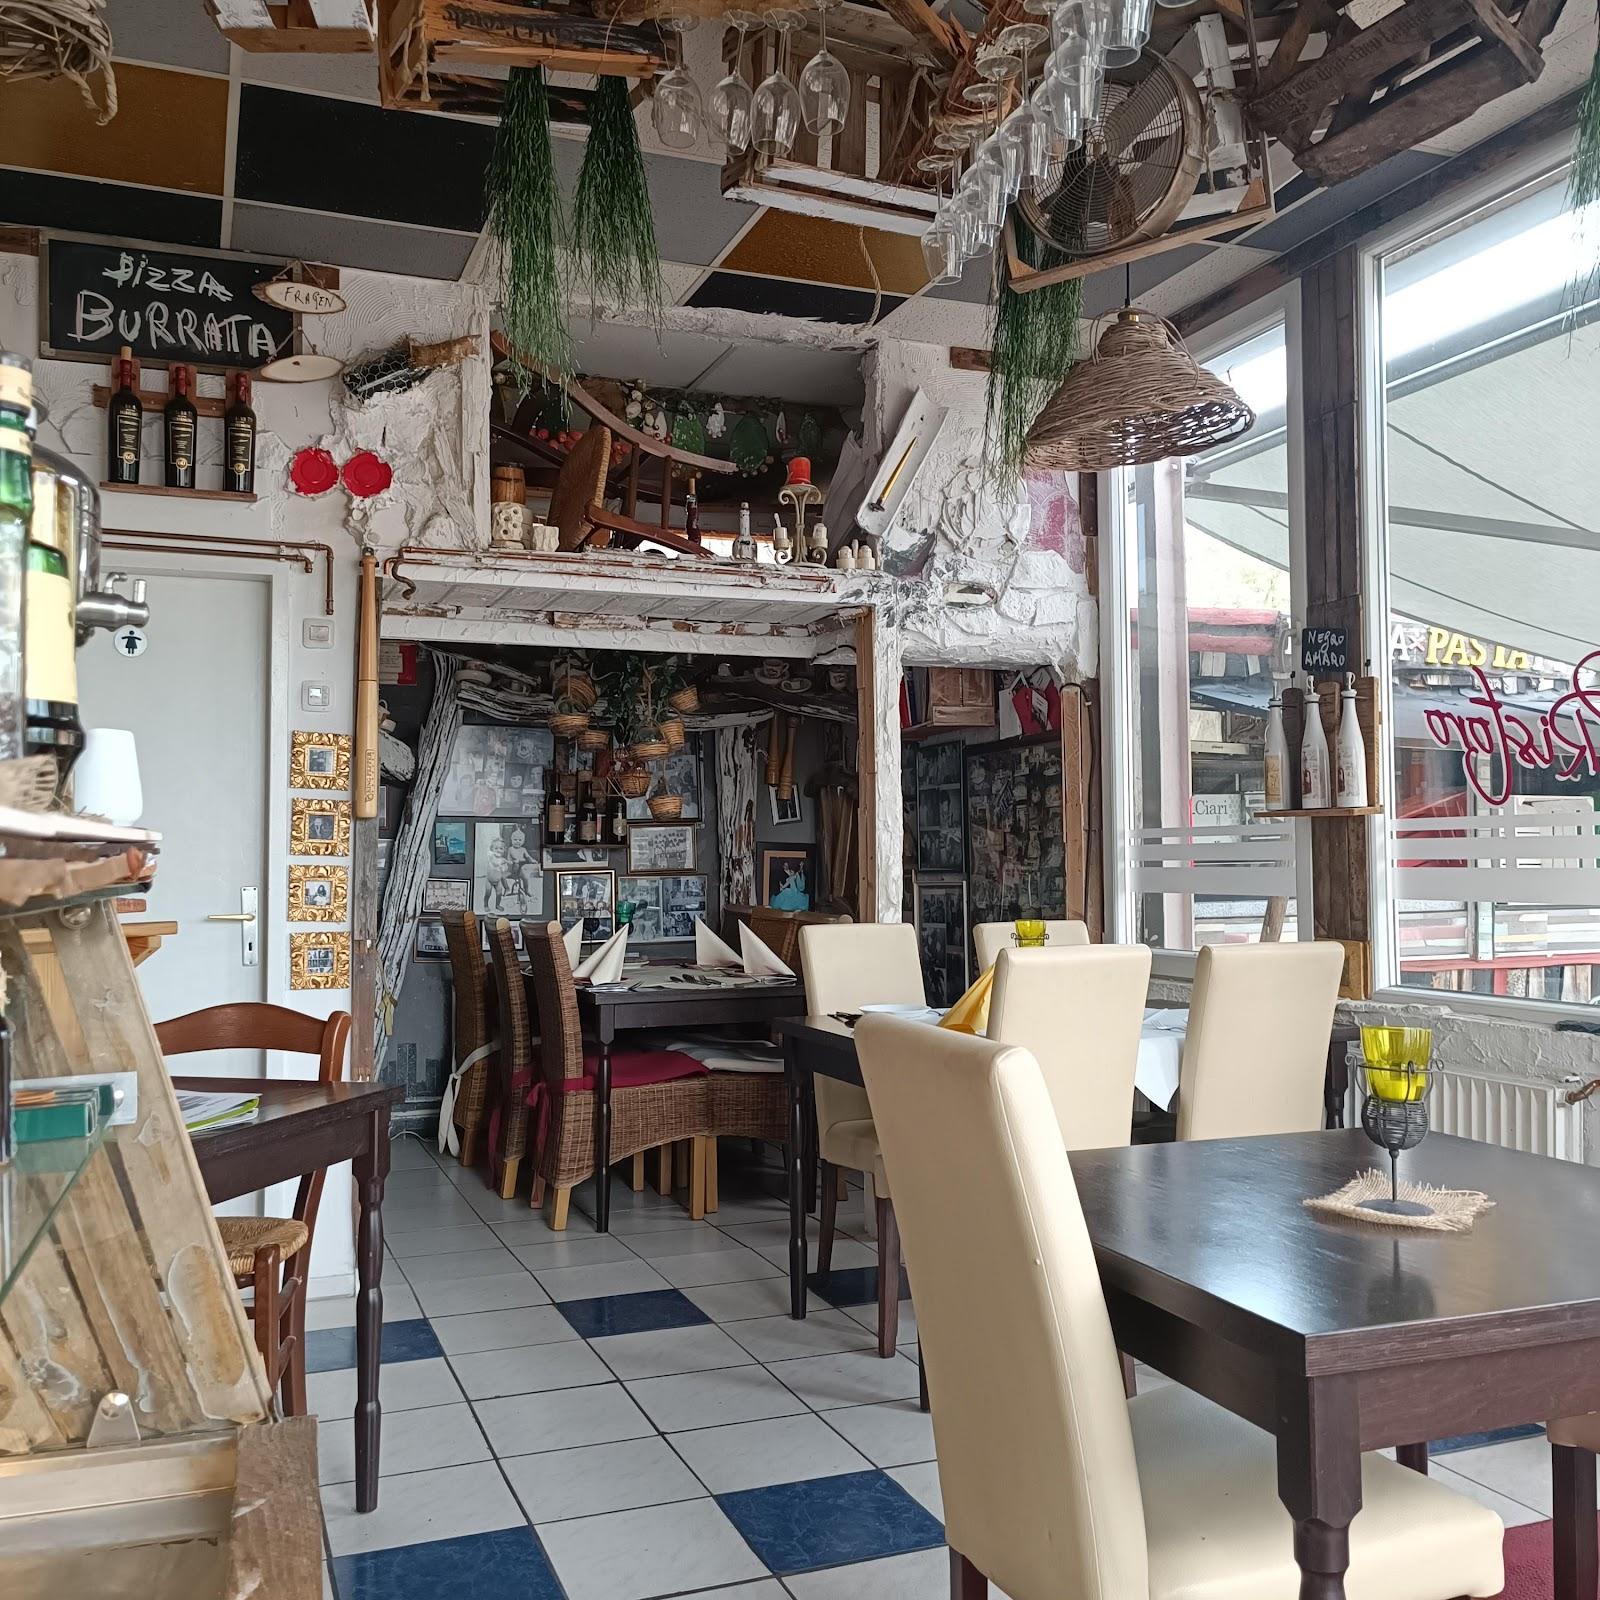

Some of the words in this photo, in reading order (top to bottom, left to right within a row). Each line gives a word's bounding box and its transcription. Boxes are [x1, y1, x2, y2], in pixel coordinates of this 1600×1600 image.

[284, 286, 334, 310] FRAGEN
[67, 289, 278, 358] BURRATA
[1305, 650, 1346, 668] AMARO
[1192, 799, 1228, 816] Ciari
